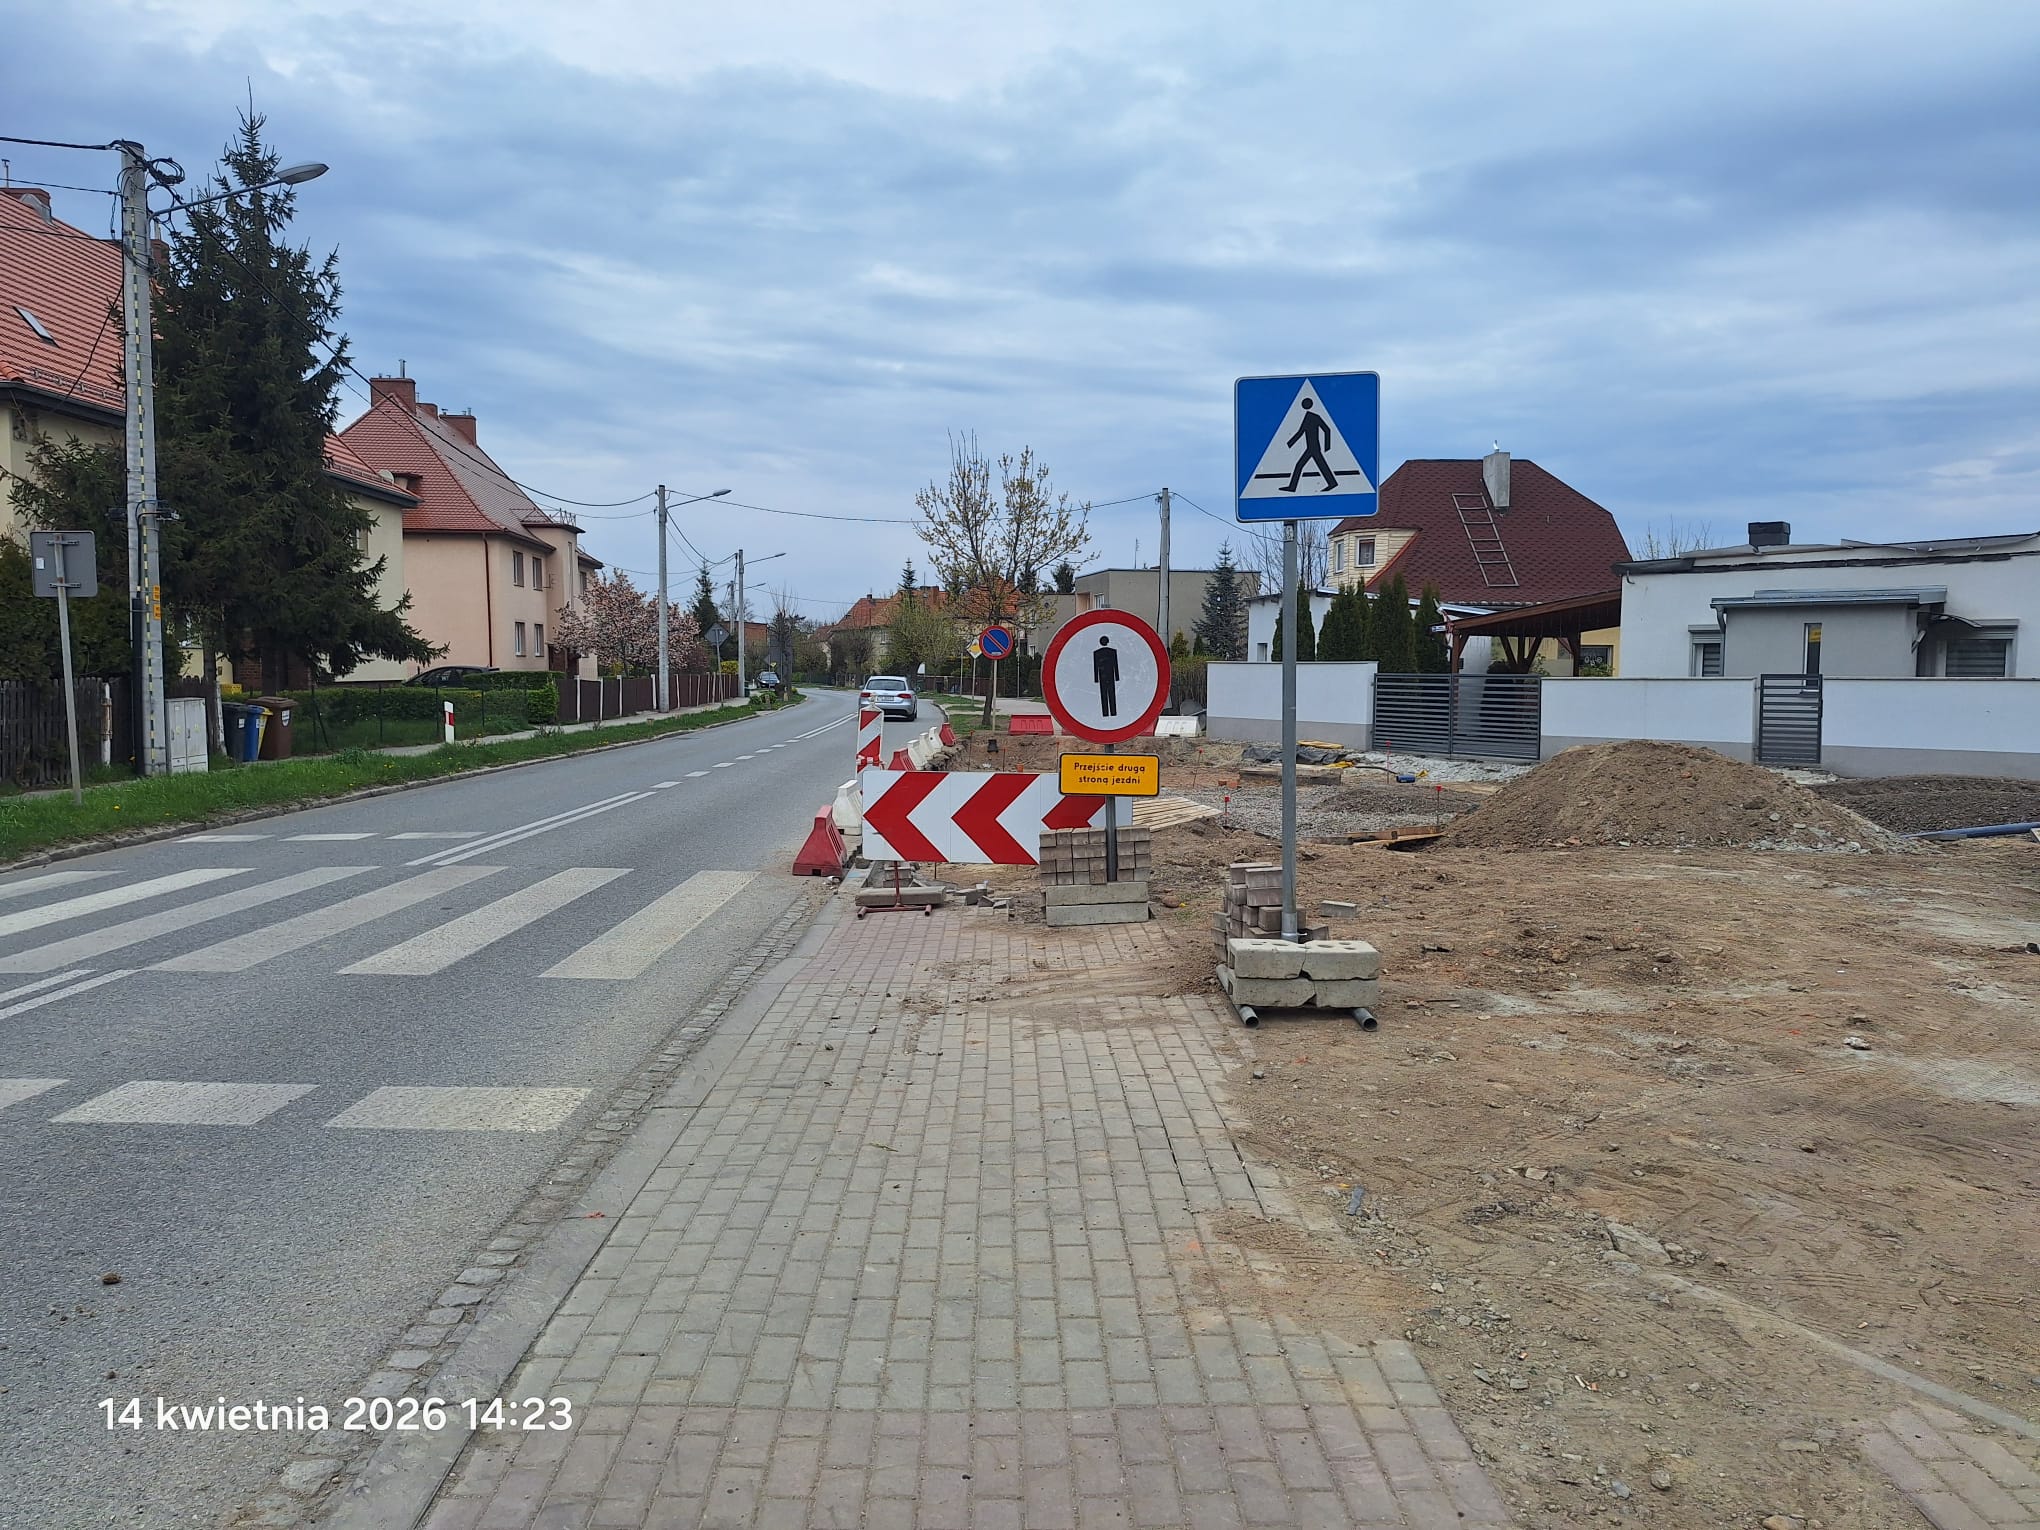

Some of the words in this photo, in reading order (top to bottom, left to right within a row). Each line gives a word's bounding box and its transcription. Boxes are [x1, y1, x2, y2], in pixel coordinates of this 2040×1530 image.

[1074, 762, 1114, 773] Przejście
[1118, 764, 1145, 774] drugą
[1079, 775, 1109, 785] stroną
[1112, 776, 1140, 785] jezdni
